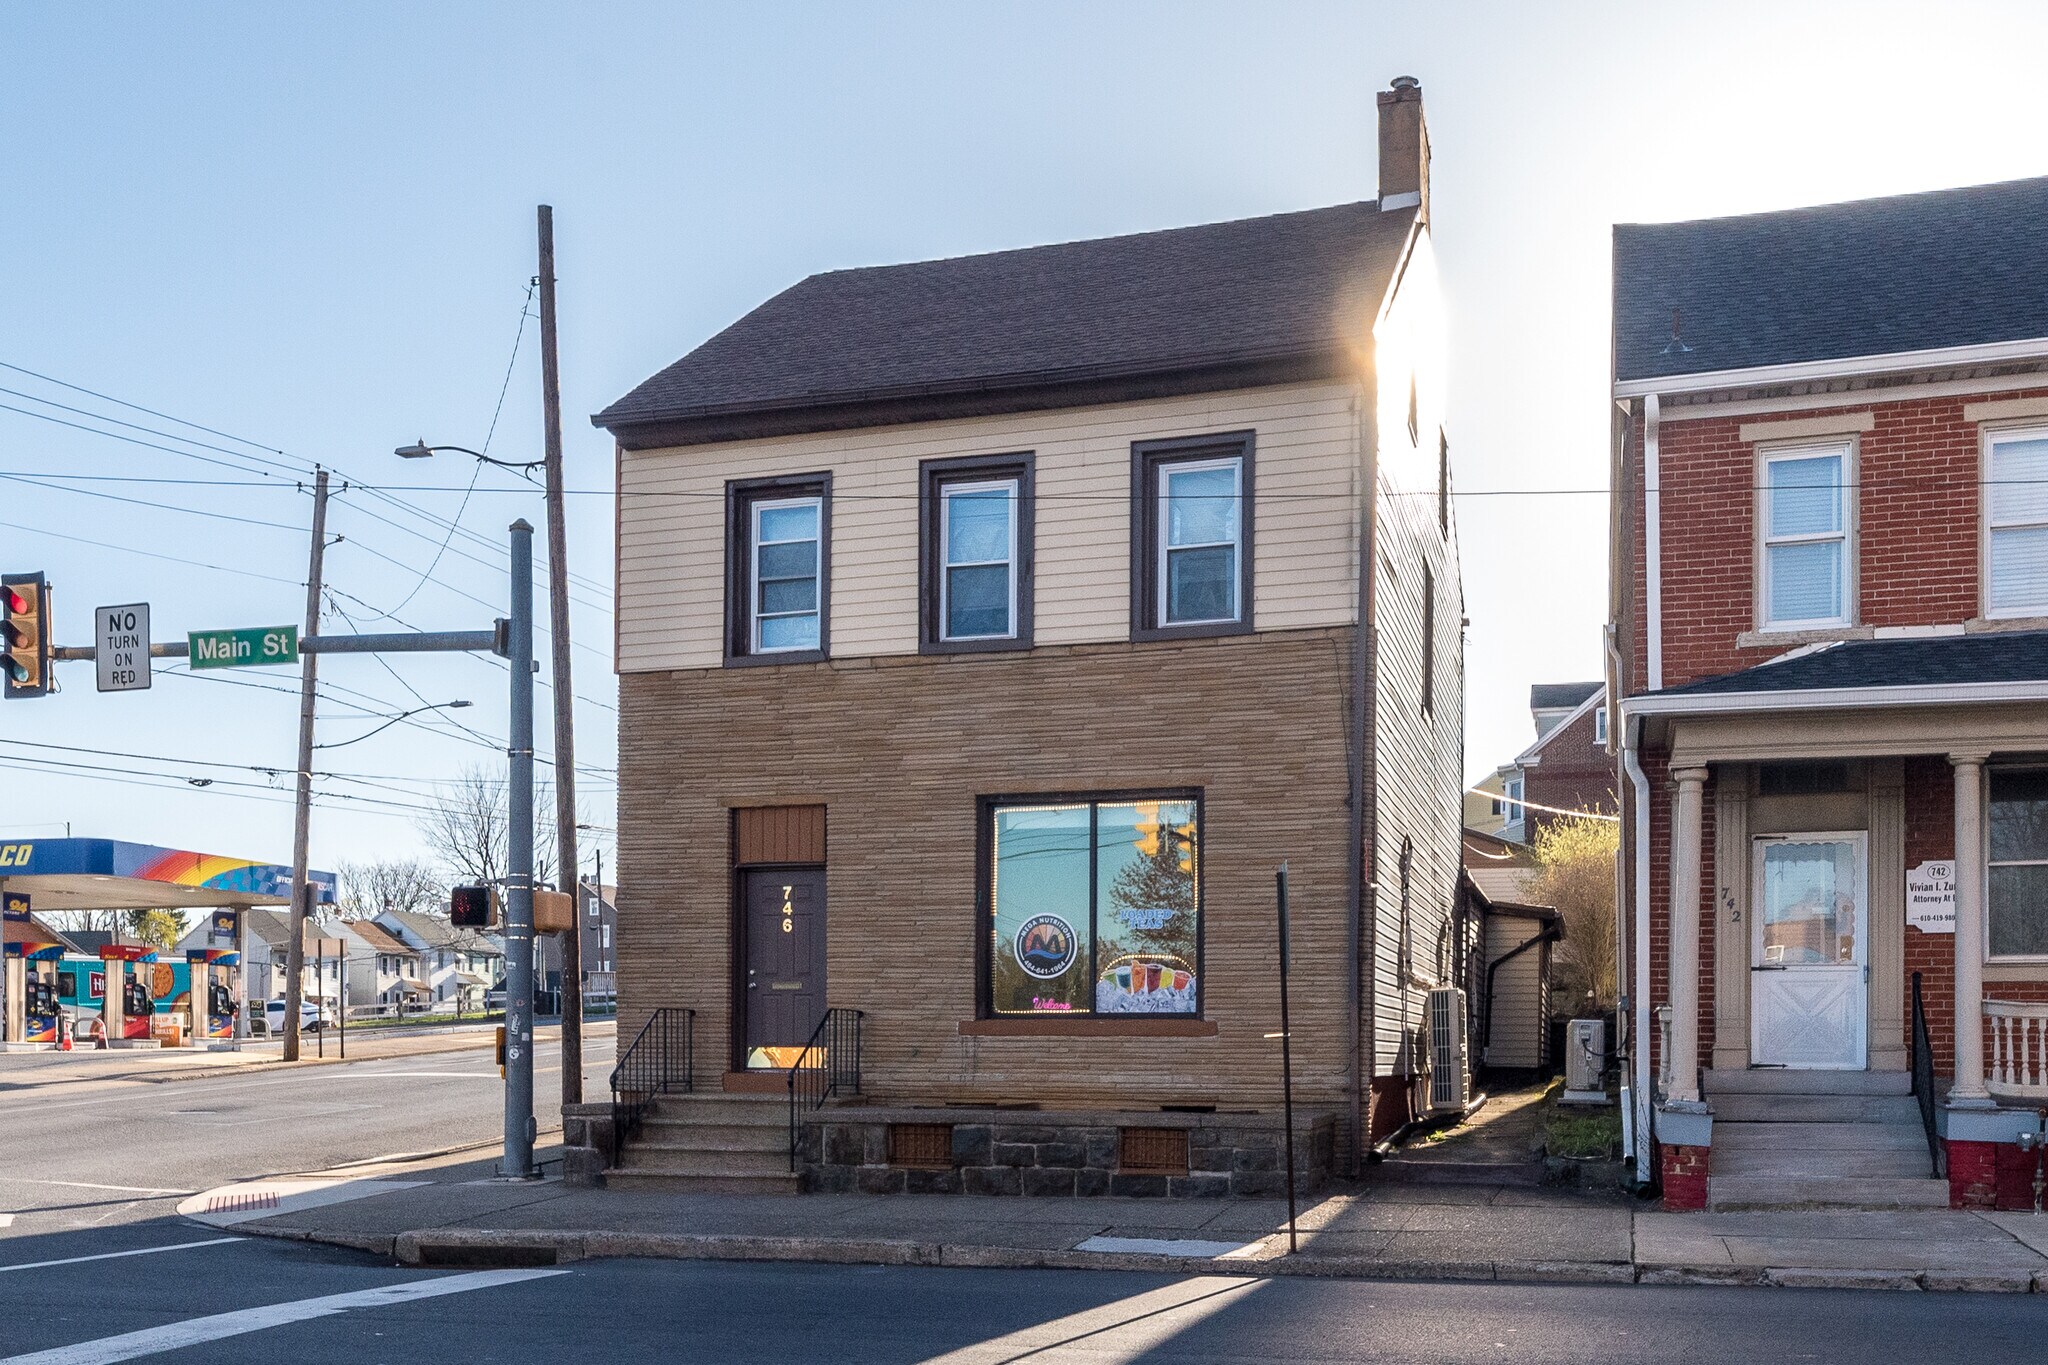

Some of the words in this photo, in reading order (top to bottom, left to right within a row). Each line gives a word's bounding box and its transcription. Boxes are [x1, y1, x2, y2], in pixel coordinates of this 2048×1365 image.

[109, 612, 136, 632] NO
[107, 634, 139, 650] TURN
[197, 636, 250, 660] Main
[263, 633, 289, 656] St
[114, 653, 133, 667] ON
[112, 670, 136, 685] RED
[0, 844, 33, 867] CO
[1932, 867, 1946, 876] 742
[1909, 883, 1934, 892] Vivian
[1936, 881, 1942, 891] I.
[1913, 894, 1942, 904] Attorney
[1943, 894, 1951, 902] At
[782, 885, 793, 933] 746
[1120, 908, 1174, 919] LOADED
[1020, 919, 1038, 938] MEGA
[1038, 917, 1072, 939] NUTRITION
[1129, 918, 1164, 929] TEAS
[1032, 996, 1071, 1010] Welcome
